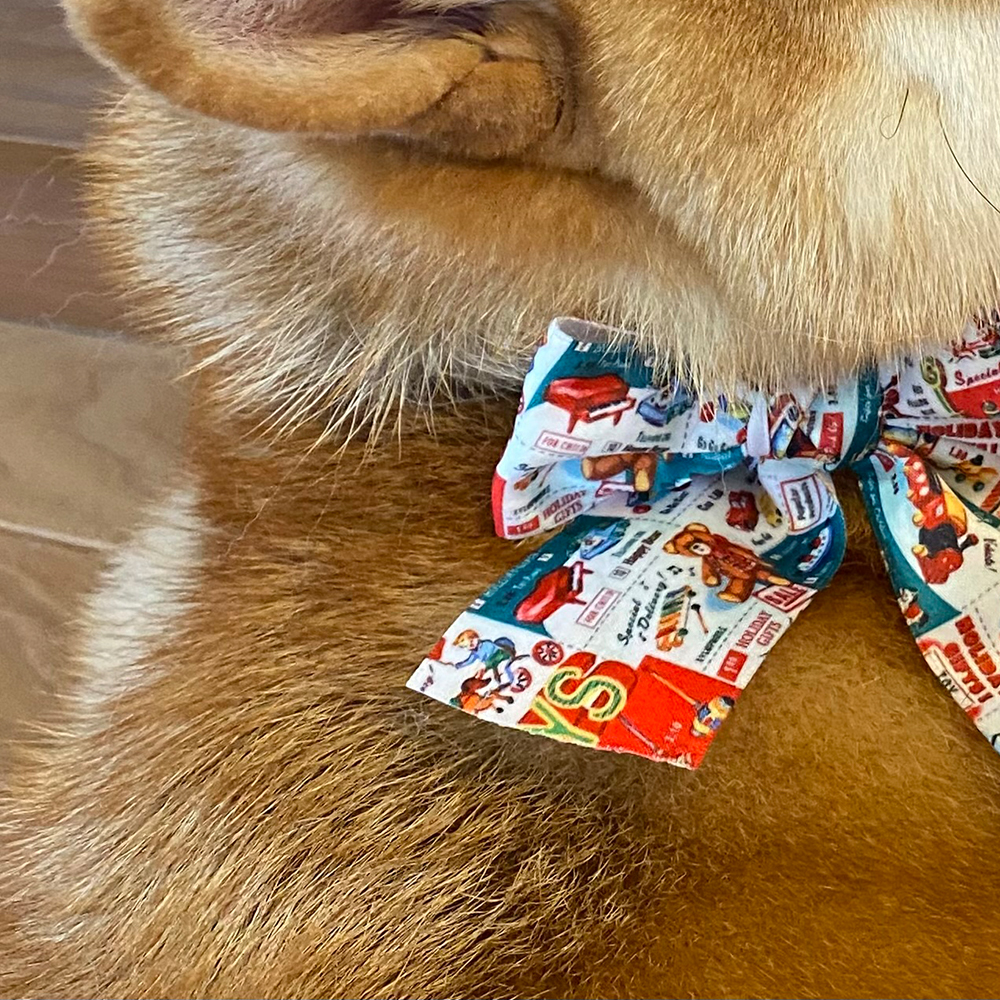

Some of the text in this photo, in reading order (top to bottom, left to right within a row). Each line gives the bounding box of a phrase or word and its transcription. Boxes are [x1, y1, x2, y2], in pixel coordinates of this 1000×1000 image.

[617, 597, 643, 647] Special
[735, 609, 773, 649] HOLIDAY
[756, 619, 782, 647] GIFTS
